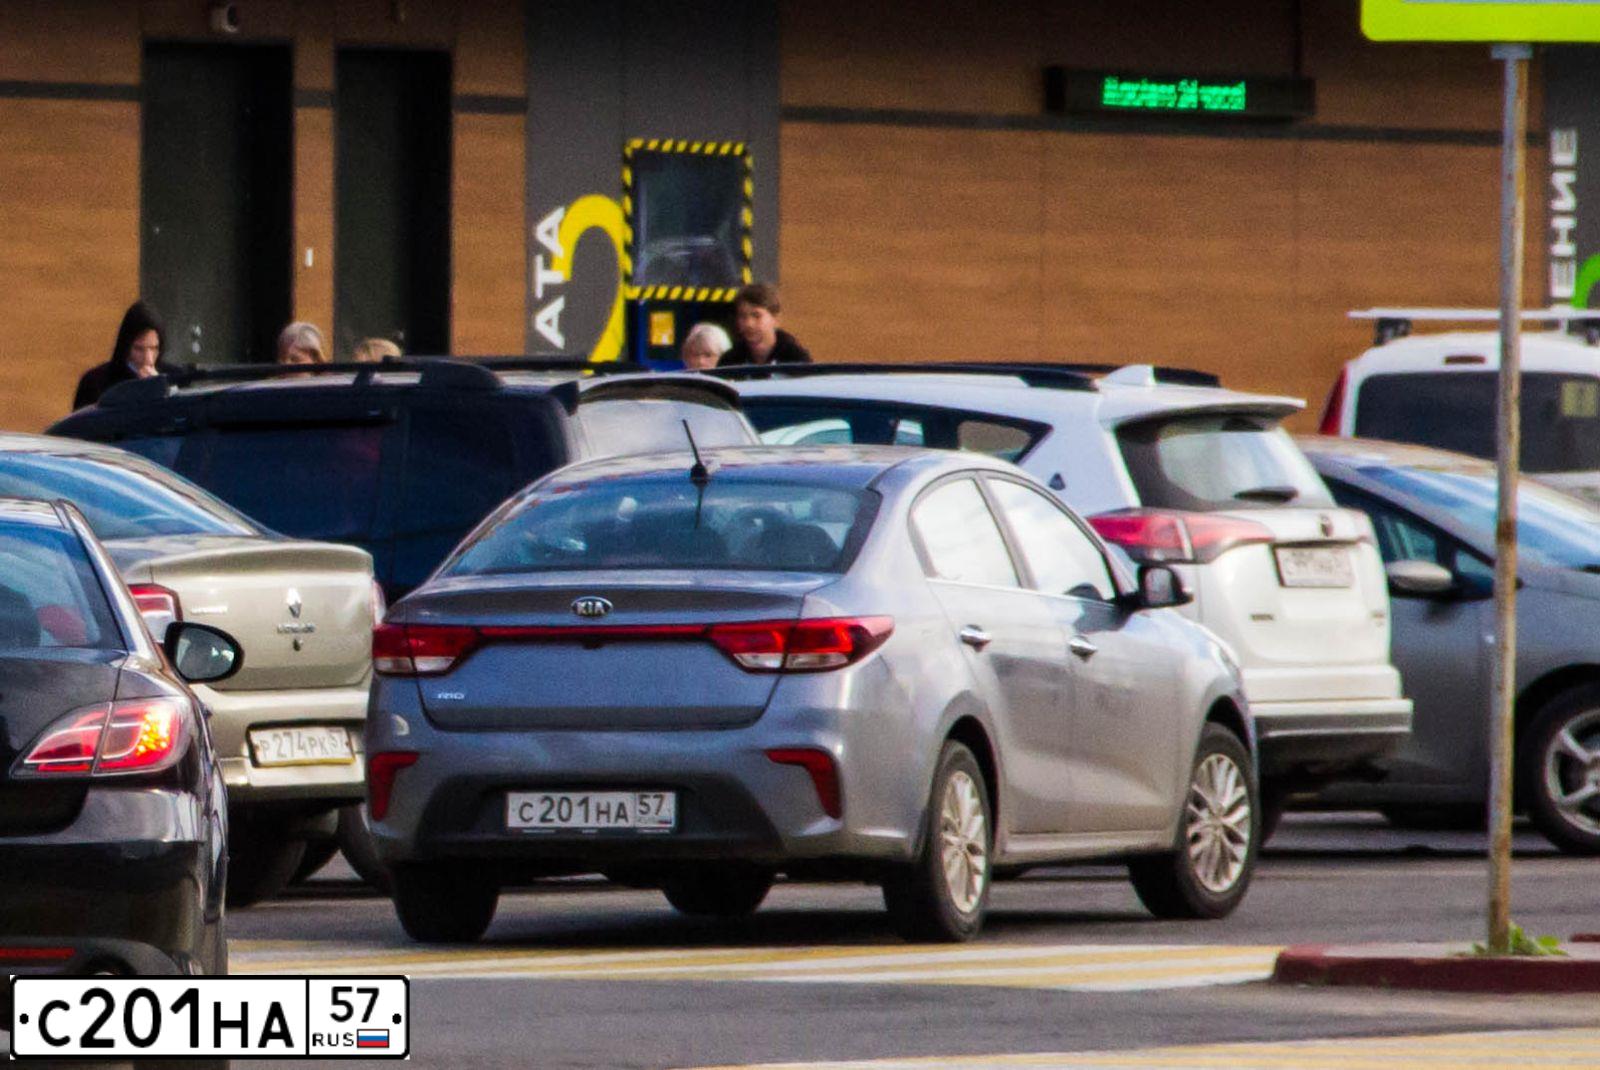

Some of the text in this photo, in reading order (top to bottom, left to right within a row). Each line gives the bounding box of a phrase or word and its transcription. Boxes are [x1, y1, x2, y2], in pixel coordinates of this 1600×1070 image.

[576, 600, 606, 616] KIA
[518, 793, 665, 823] С201НА 57
